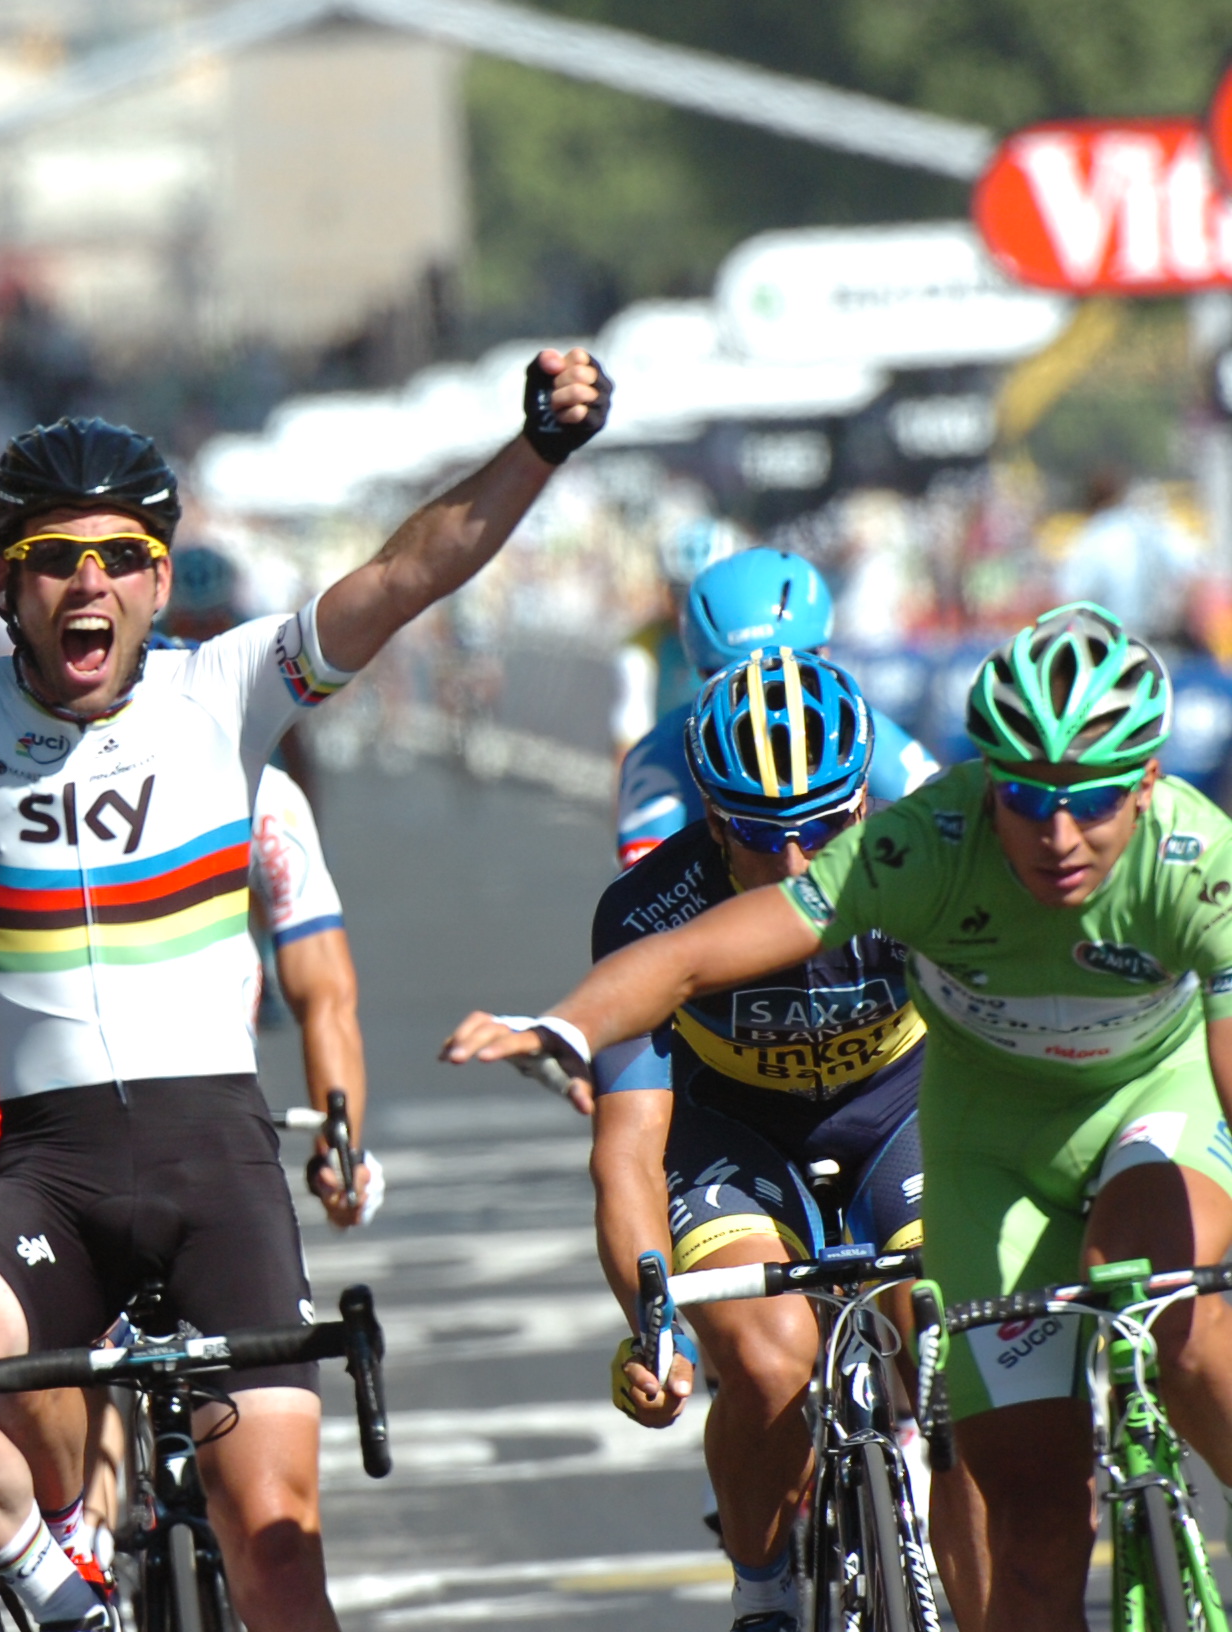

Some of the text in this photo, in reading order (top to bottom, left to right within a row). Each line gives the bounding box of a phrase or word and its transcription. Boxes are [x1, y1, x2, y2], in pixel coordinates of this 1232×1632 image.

[622, 861, 704, 932] Tinkoff
[750, 998, 879, 1029] SAXO
[751, 1011, 882, 1044] BANK
[757, 1048, 884, 1080] Bank
